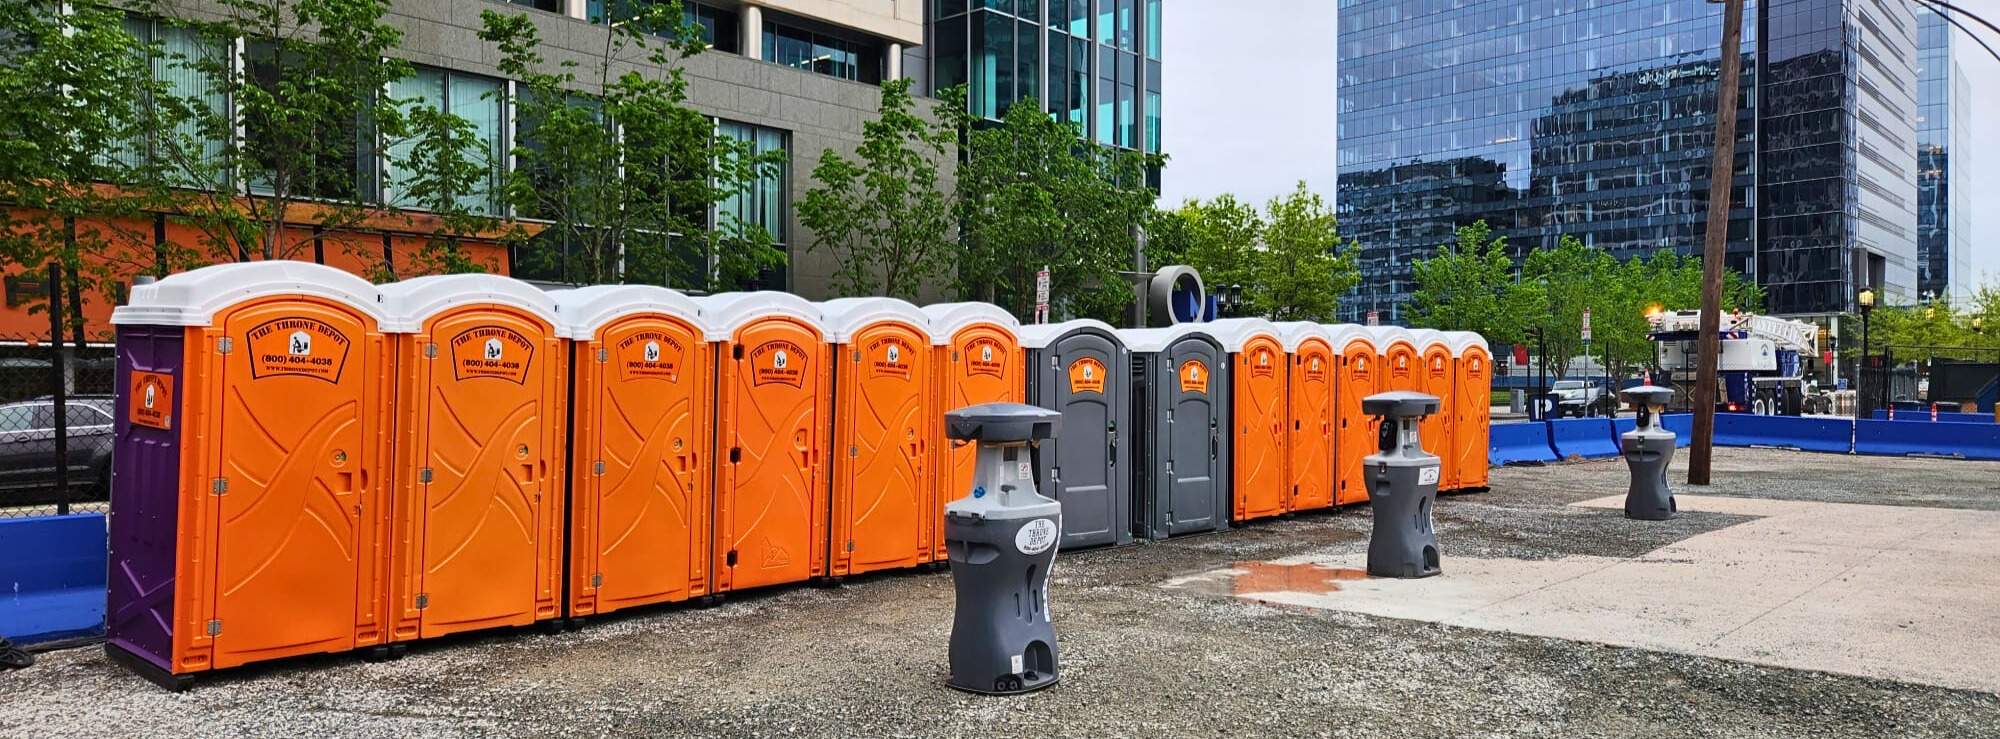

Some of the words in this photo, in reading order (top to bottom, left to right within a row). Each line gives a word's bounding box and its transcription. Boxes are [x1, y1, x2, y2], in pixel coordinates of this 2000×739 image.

[251, 325, 273, 340] THE
[275, 320, 316, 330] THRONE
[317, 325, 346, 345] DEPOT
[454, 333, 473, 347] THE
[473, 328, 506, 338] THRONE
[507, 332, 531, 351] DEPOT
[620, 337, 635, 350] THE
[635, 332, 662, 341] THRONE
[663, 335, 682, 352] DEPOT
[261, 354, 287, 364] (800)
[288, 356, 333, 366] 404-4038
[462, 359, 483, 368] (800)
[484, 360, 520, 369] 404-4038
[626, 361, 643, 369] (800)
